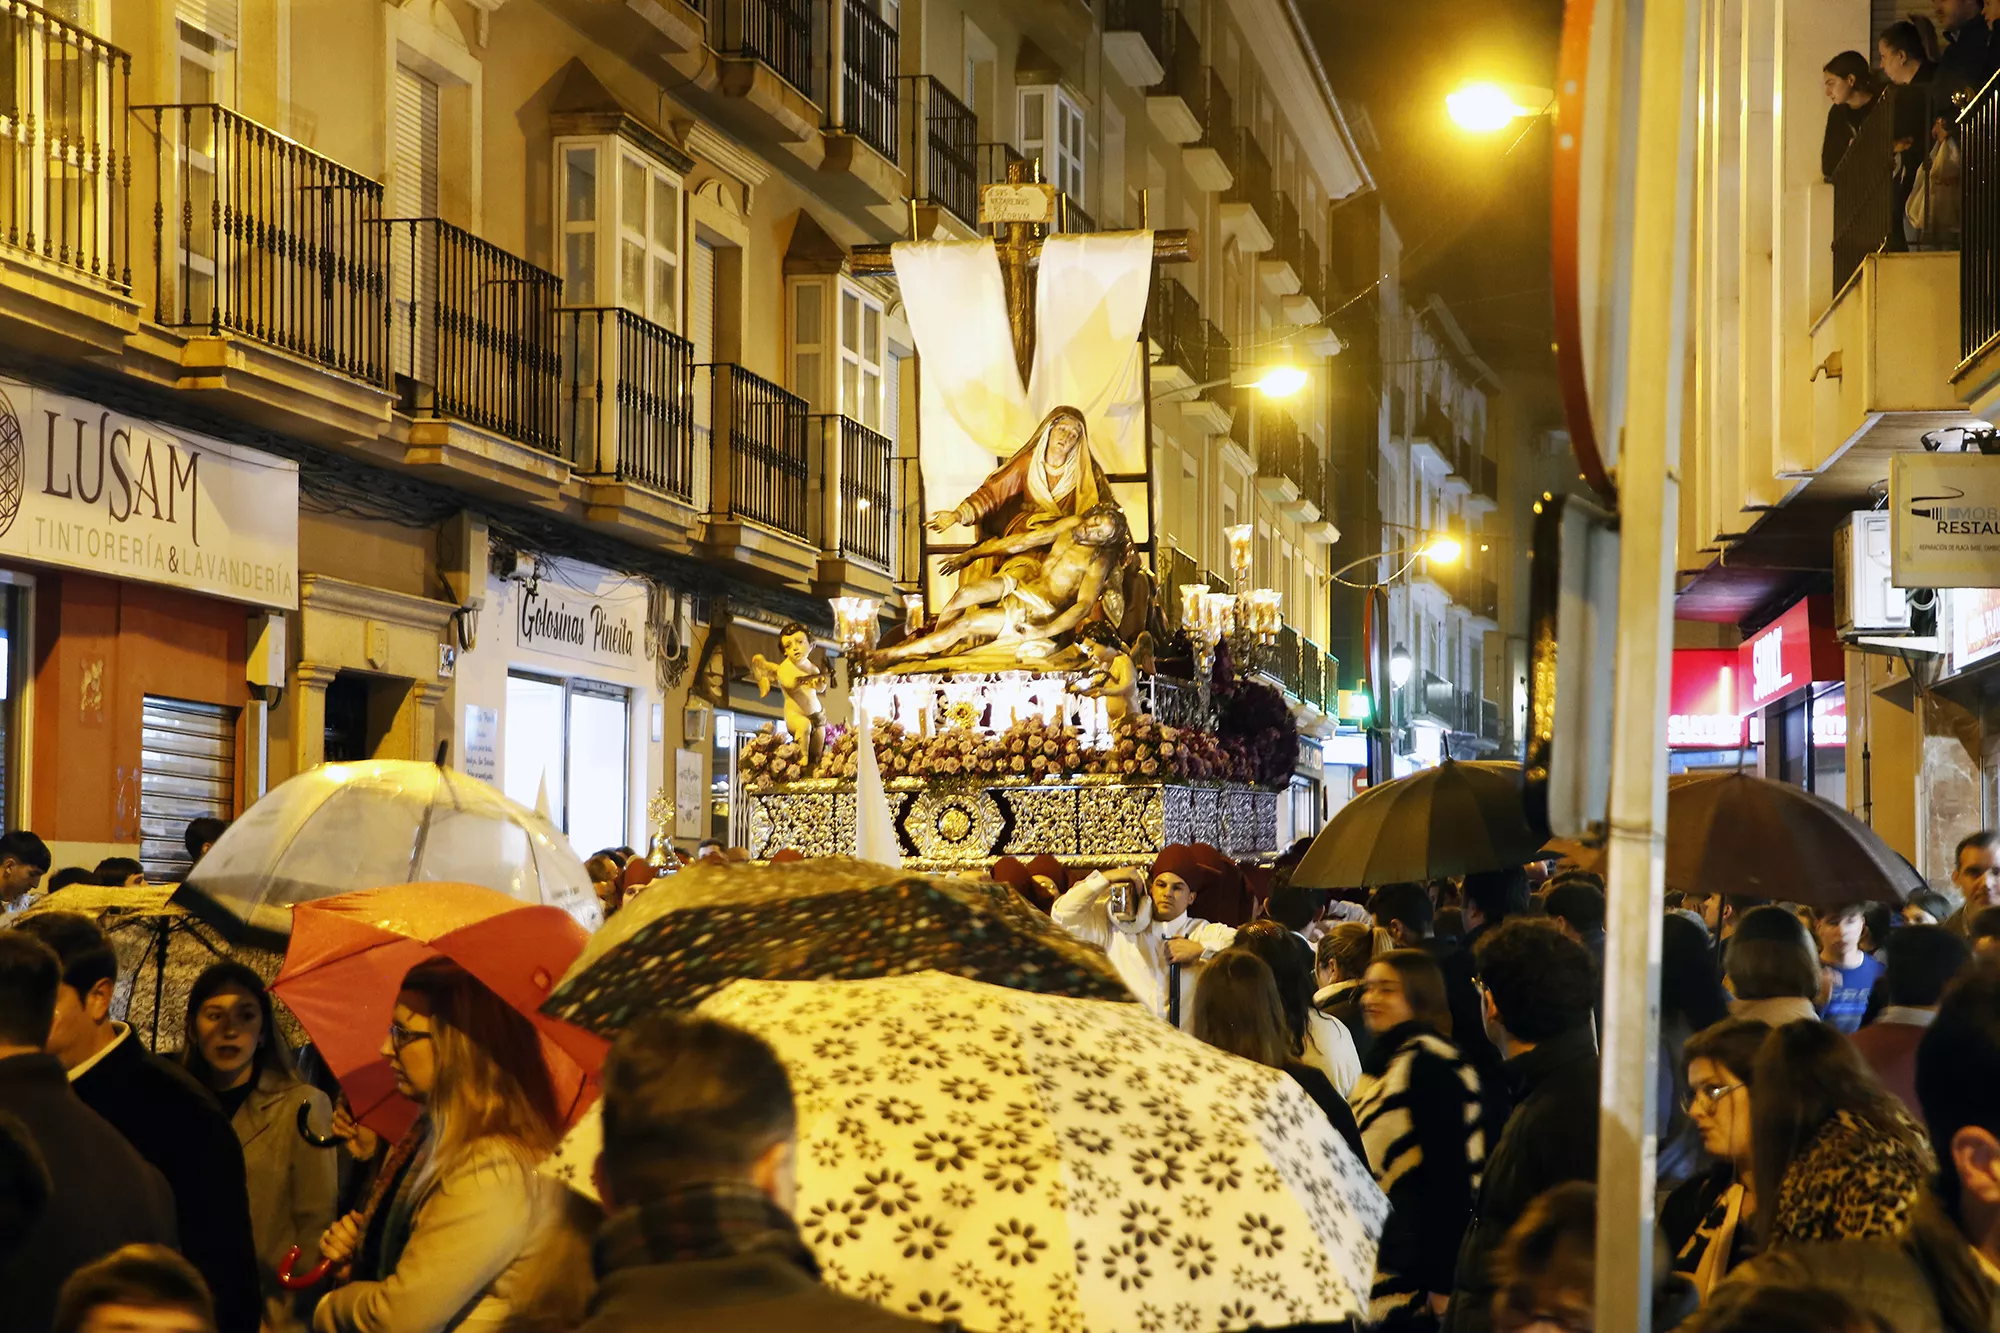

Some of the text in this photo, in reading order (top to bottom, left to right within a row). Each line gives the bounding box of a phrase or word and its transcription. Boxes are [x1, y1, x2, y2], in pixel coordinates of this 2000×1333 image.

[42, 409, 201, 547] LUSAM
[522, 588, 633, 656] Golosinas Pineita
